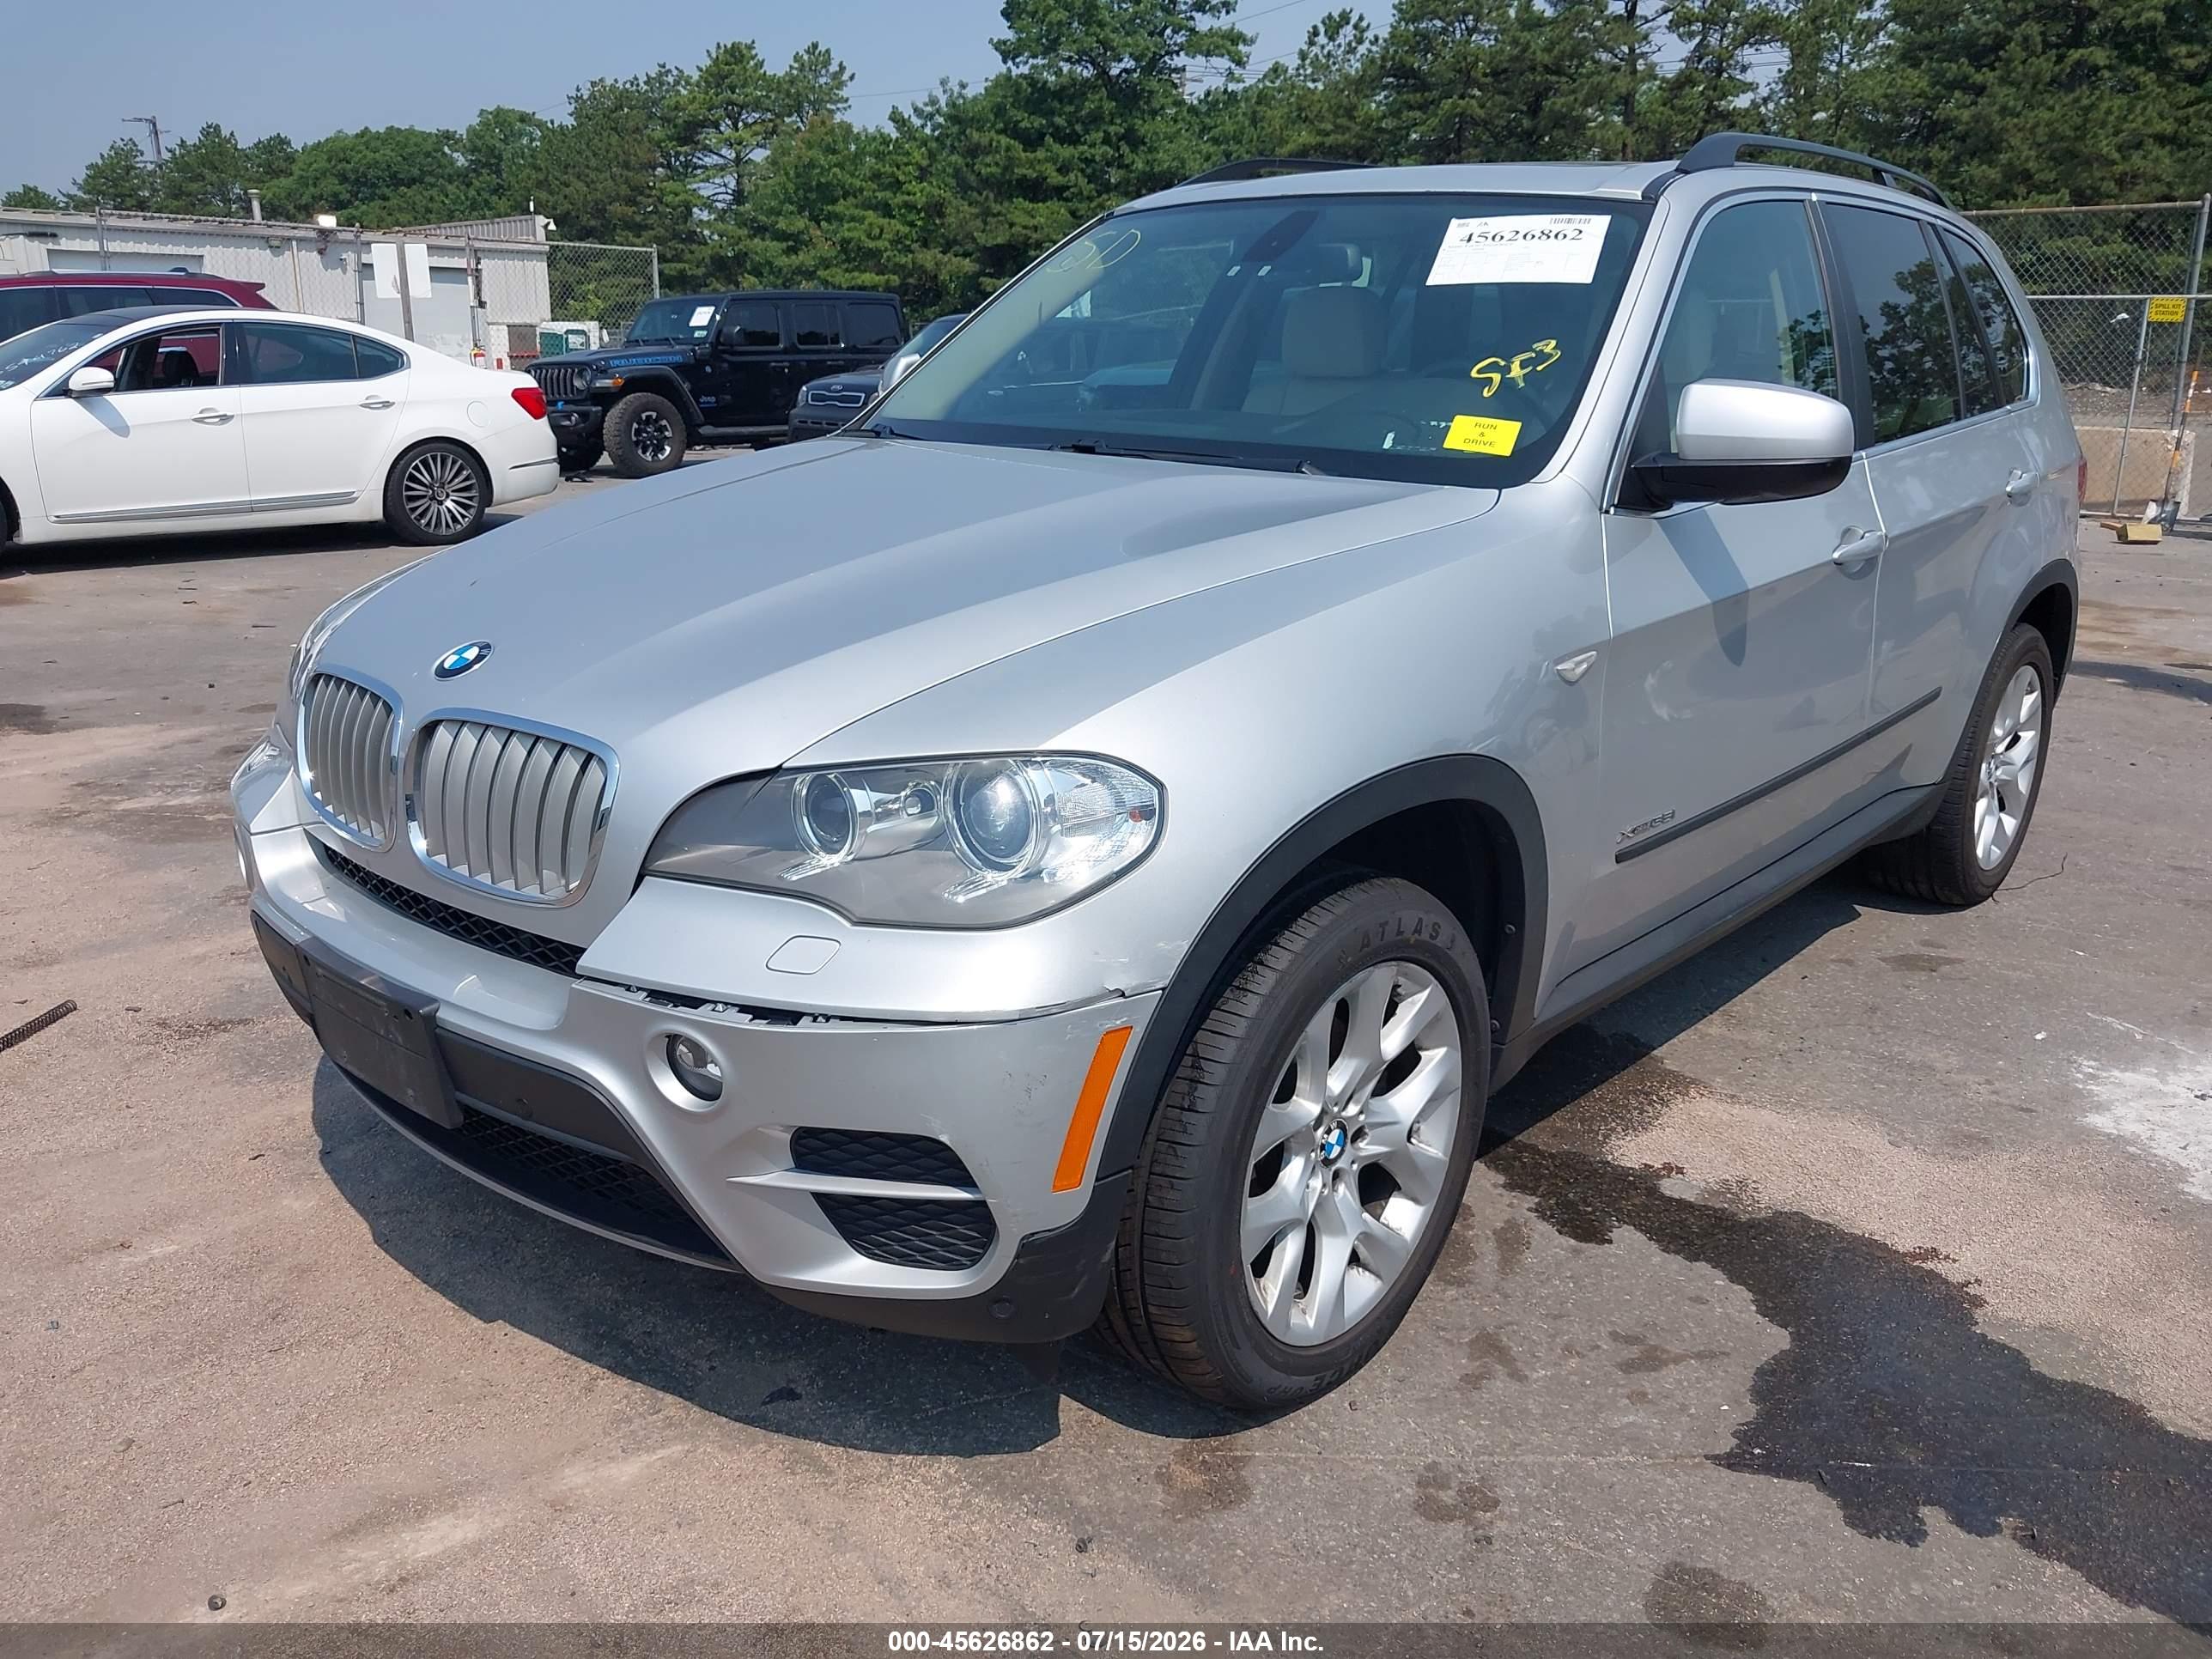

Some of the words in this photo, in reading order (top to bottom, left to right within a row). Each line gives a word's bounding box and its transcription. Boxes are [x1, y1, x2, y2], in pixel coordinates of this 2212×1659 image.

[1459, 228, 1584, 244] 45626862
[1474, 422, 1498, 430] RUN
[1463, 438, 1497, 448] DRIVE
[1359, 916, 1443, 953] ATLAS
